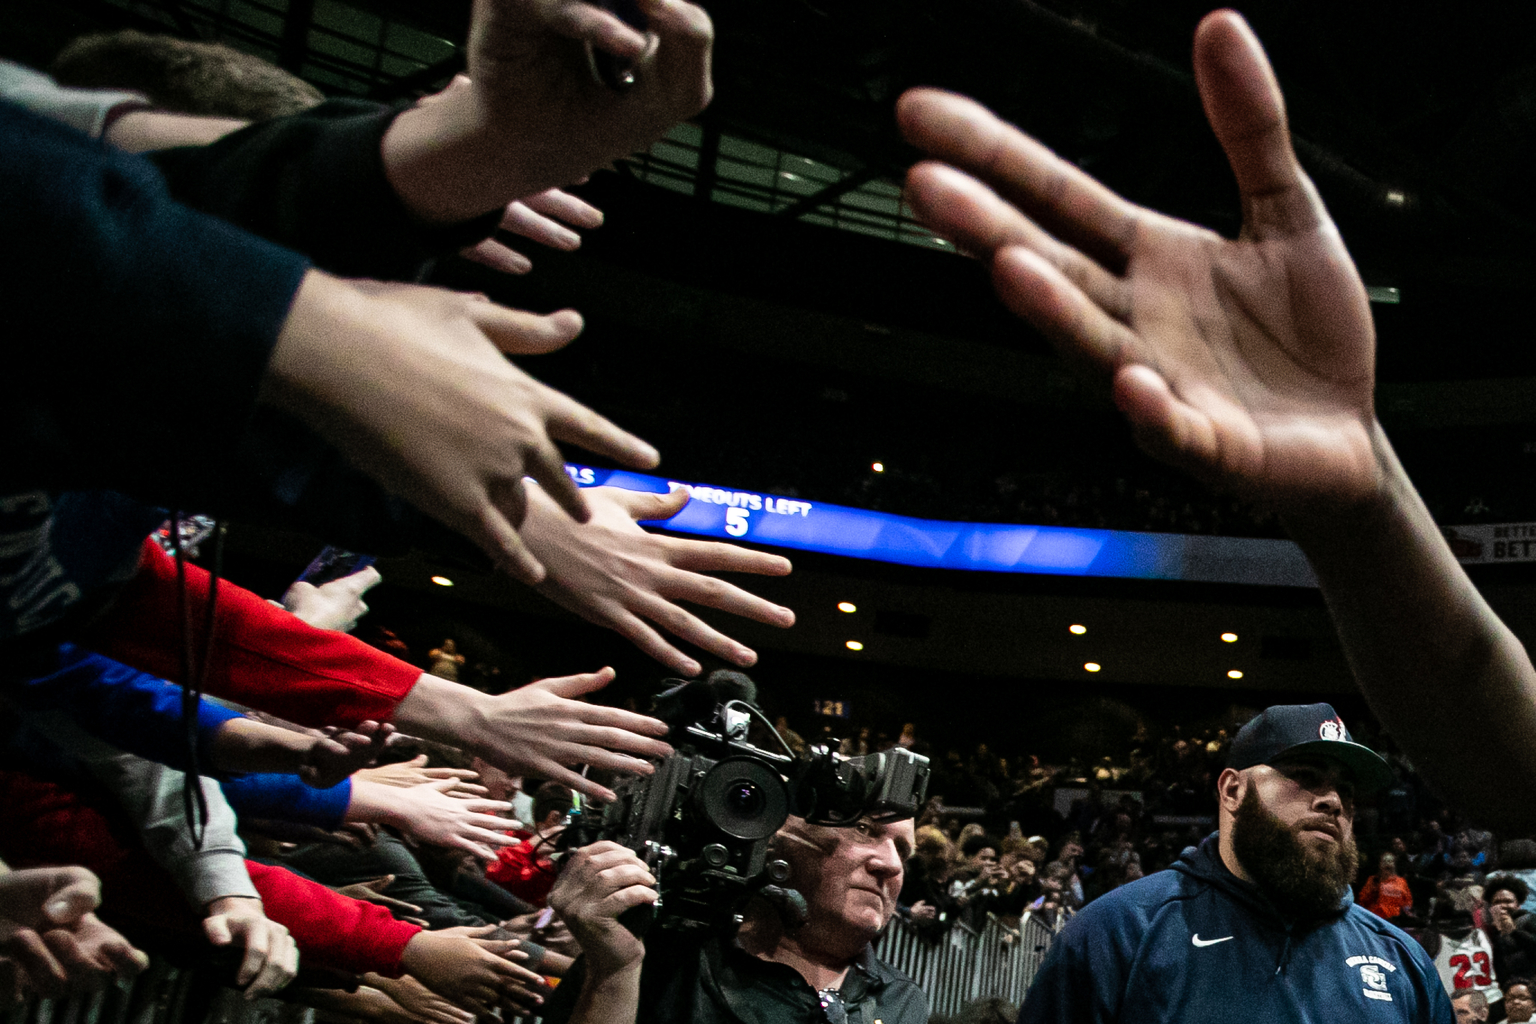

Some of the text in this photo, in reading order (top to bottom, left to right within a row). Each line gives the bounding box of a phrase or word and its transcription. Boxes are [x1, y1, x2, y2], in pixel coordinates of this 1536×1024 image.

[725, 507, 750, 537] 5
[765, 498, 812, 516] LEFT
[1449, 951, 1491, 989] 23
